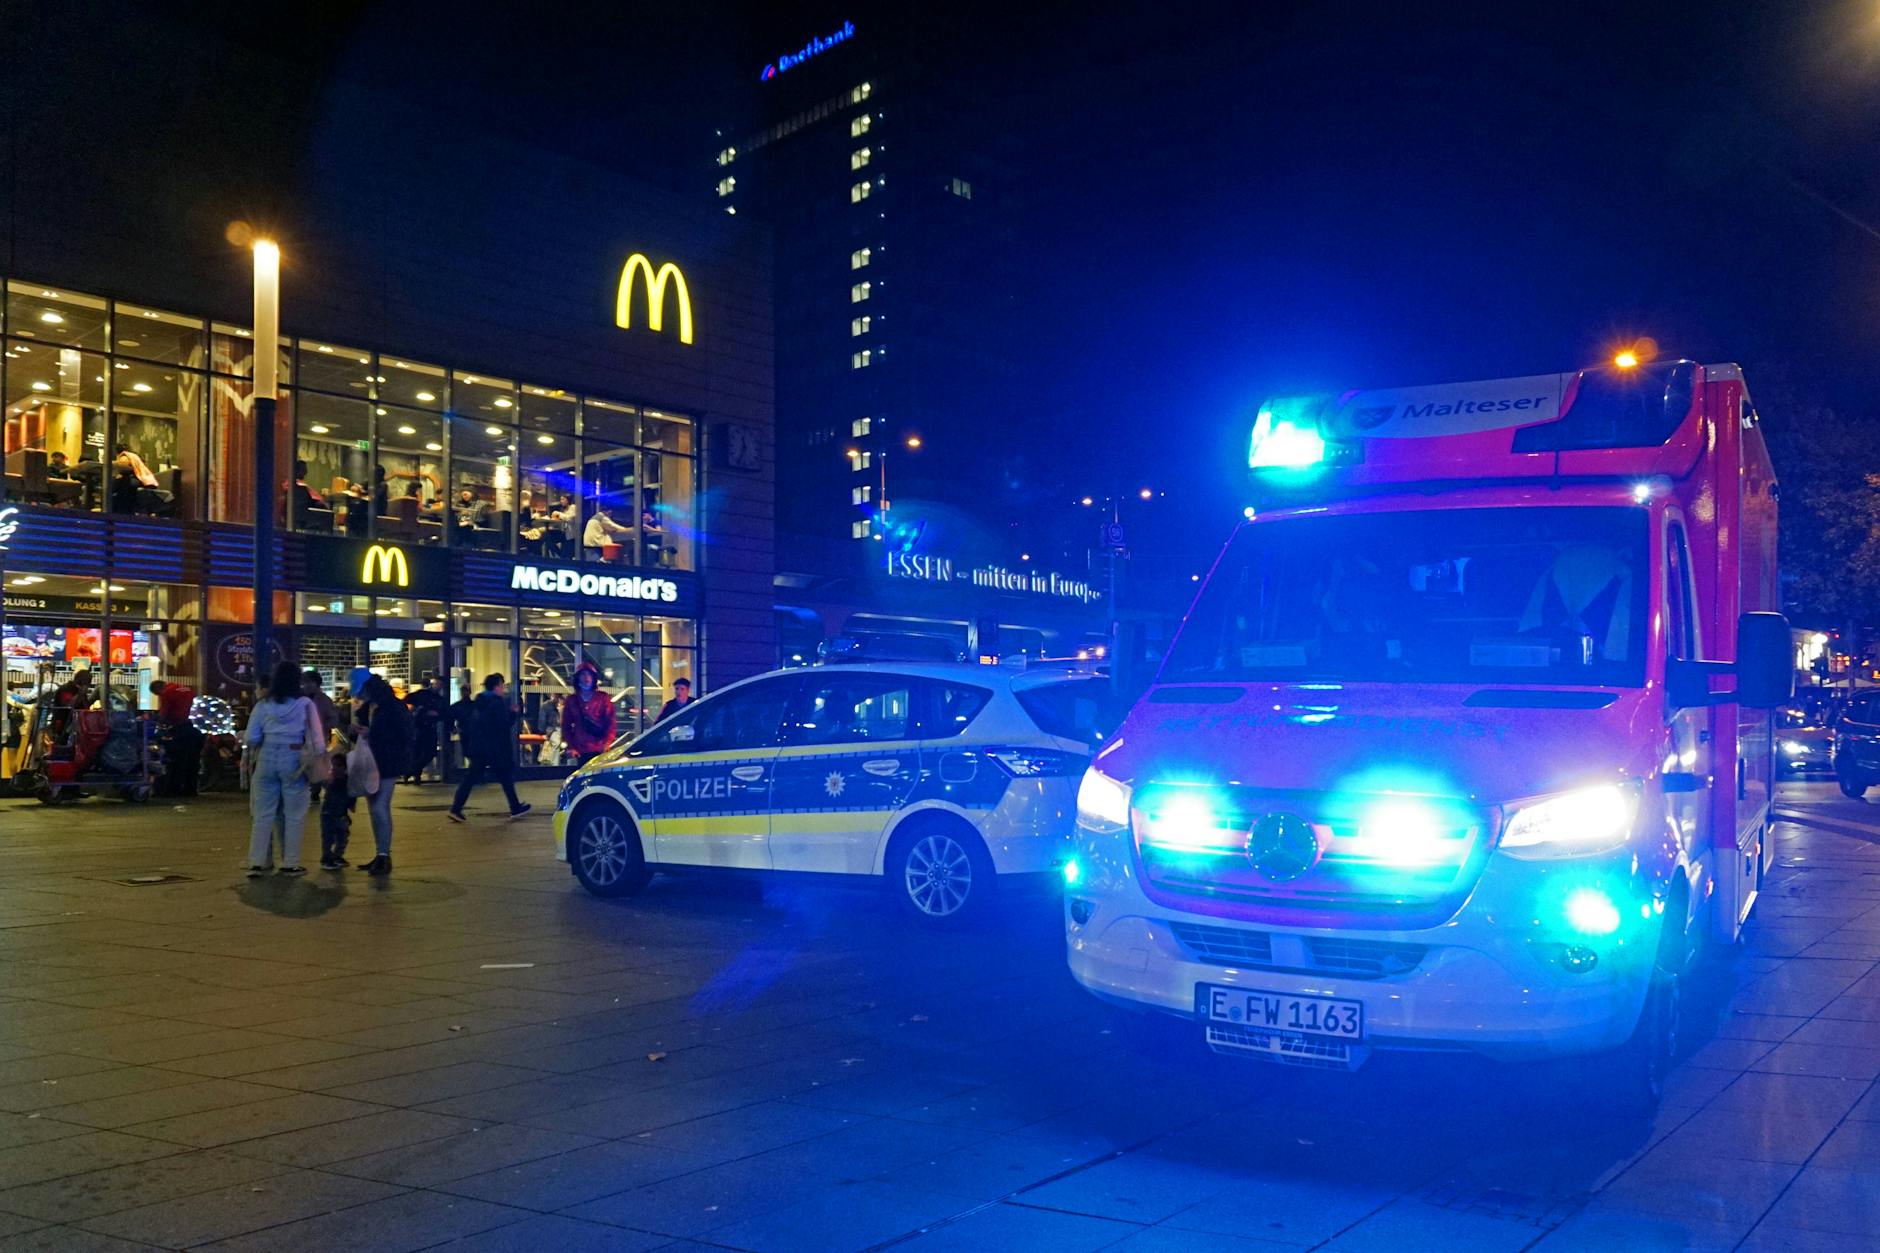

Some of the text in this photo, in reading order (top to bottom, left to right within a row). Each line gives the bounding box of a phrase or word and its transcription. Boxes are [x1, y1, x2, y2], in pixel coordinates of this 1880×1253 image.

[1401, 396, 1549, 419] Malteser
[511, 565, 678, 602] McDonald's
[887, 551, 952, 582] ESSEN
[972, 564, 1028, 591] mitten
[1031, 569, 1047, 593] in
[75, 602, 102, 611] KASS
[654, 776, 732, 801] POLIZEI
[1212, 991, 1358, 1034] E FW 1163
